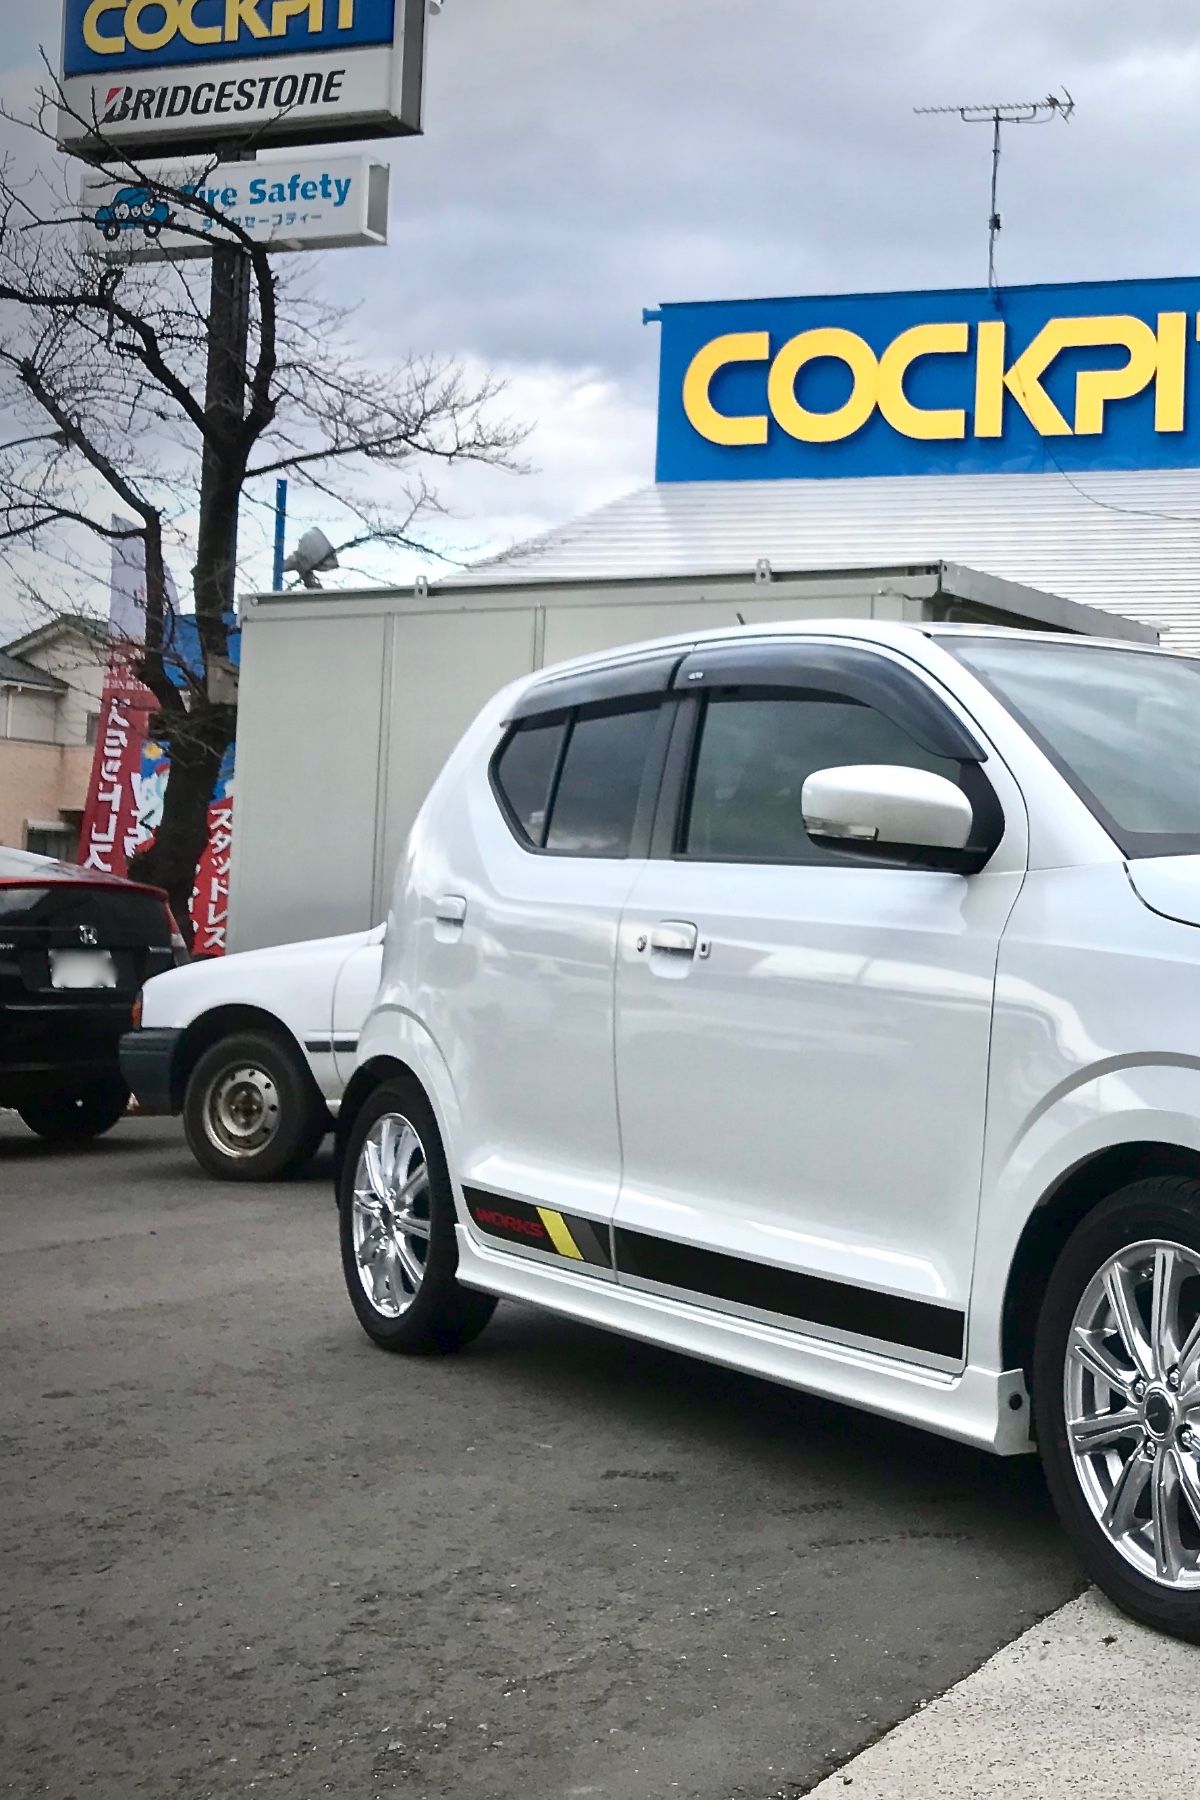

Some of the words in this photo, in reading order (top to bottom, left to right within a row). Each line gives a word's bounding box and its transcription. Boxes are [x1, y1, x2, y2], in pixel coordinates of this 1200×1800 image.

[103, 69, 346, 124] BRIDGESTONE
[249, 173, 352, 207] Safety
[476, 1208, 544, 1238] WORKS
